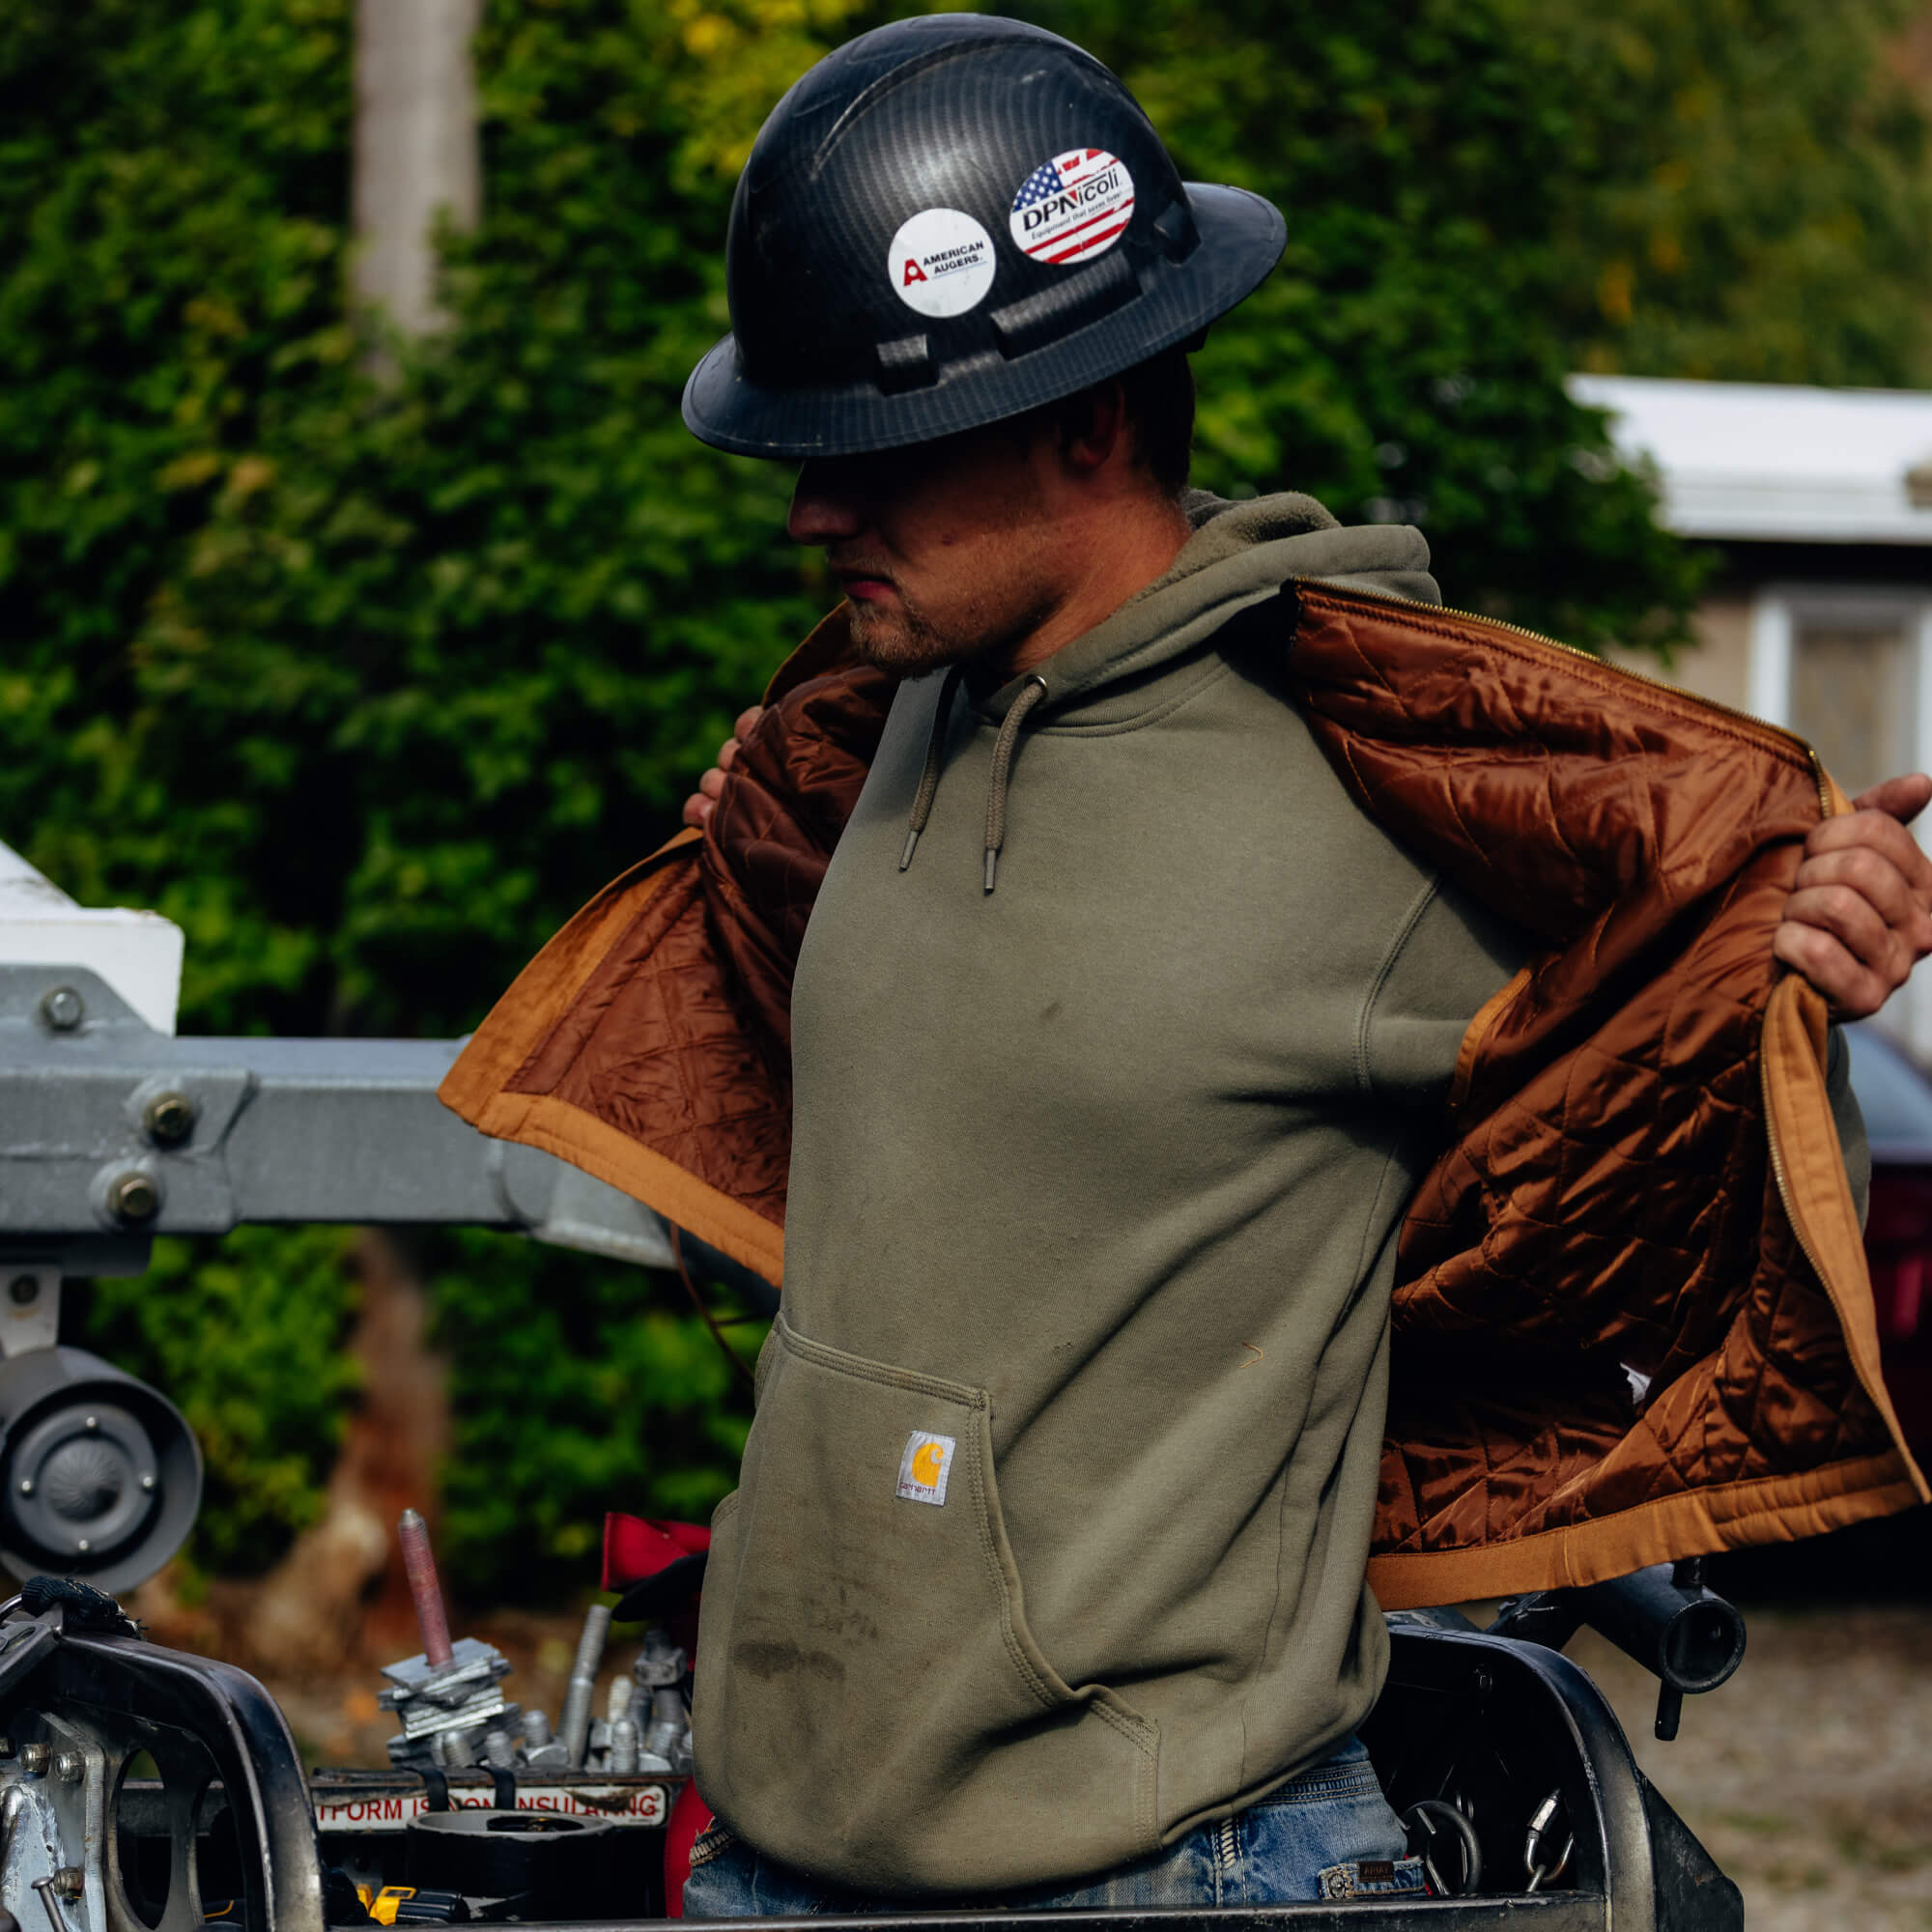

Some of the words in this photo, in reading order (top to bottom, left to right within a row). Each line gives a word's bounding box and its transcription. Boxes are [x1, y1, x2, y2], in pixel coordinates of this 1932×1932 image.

[923, 241, 983, 267] AMERICAN
[903, 258, 928, 287] A
[517, 1795, 656, 1817] NSULANG
